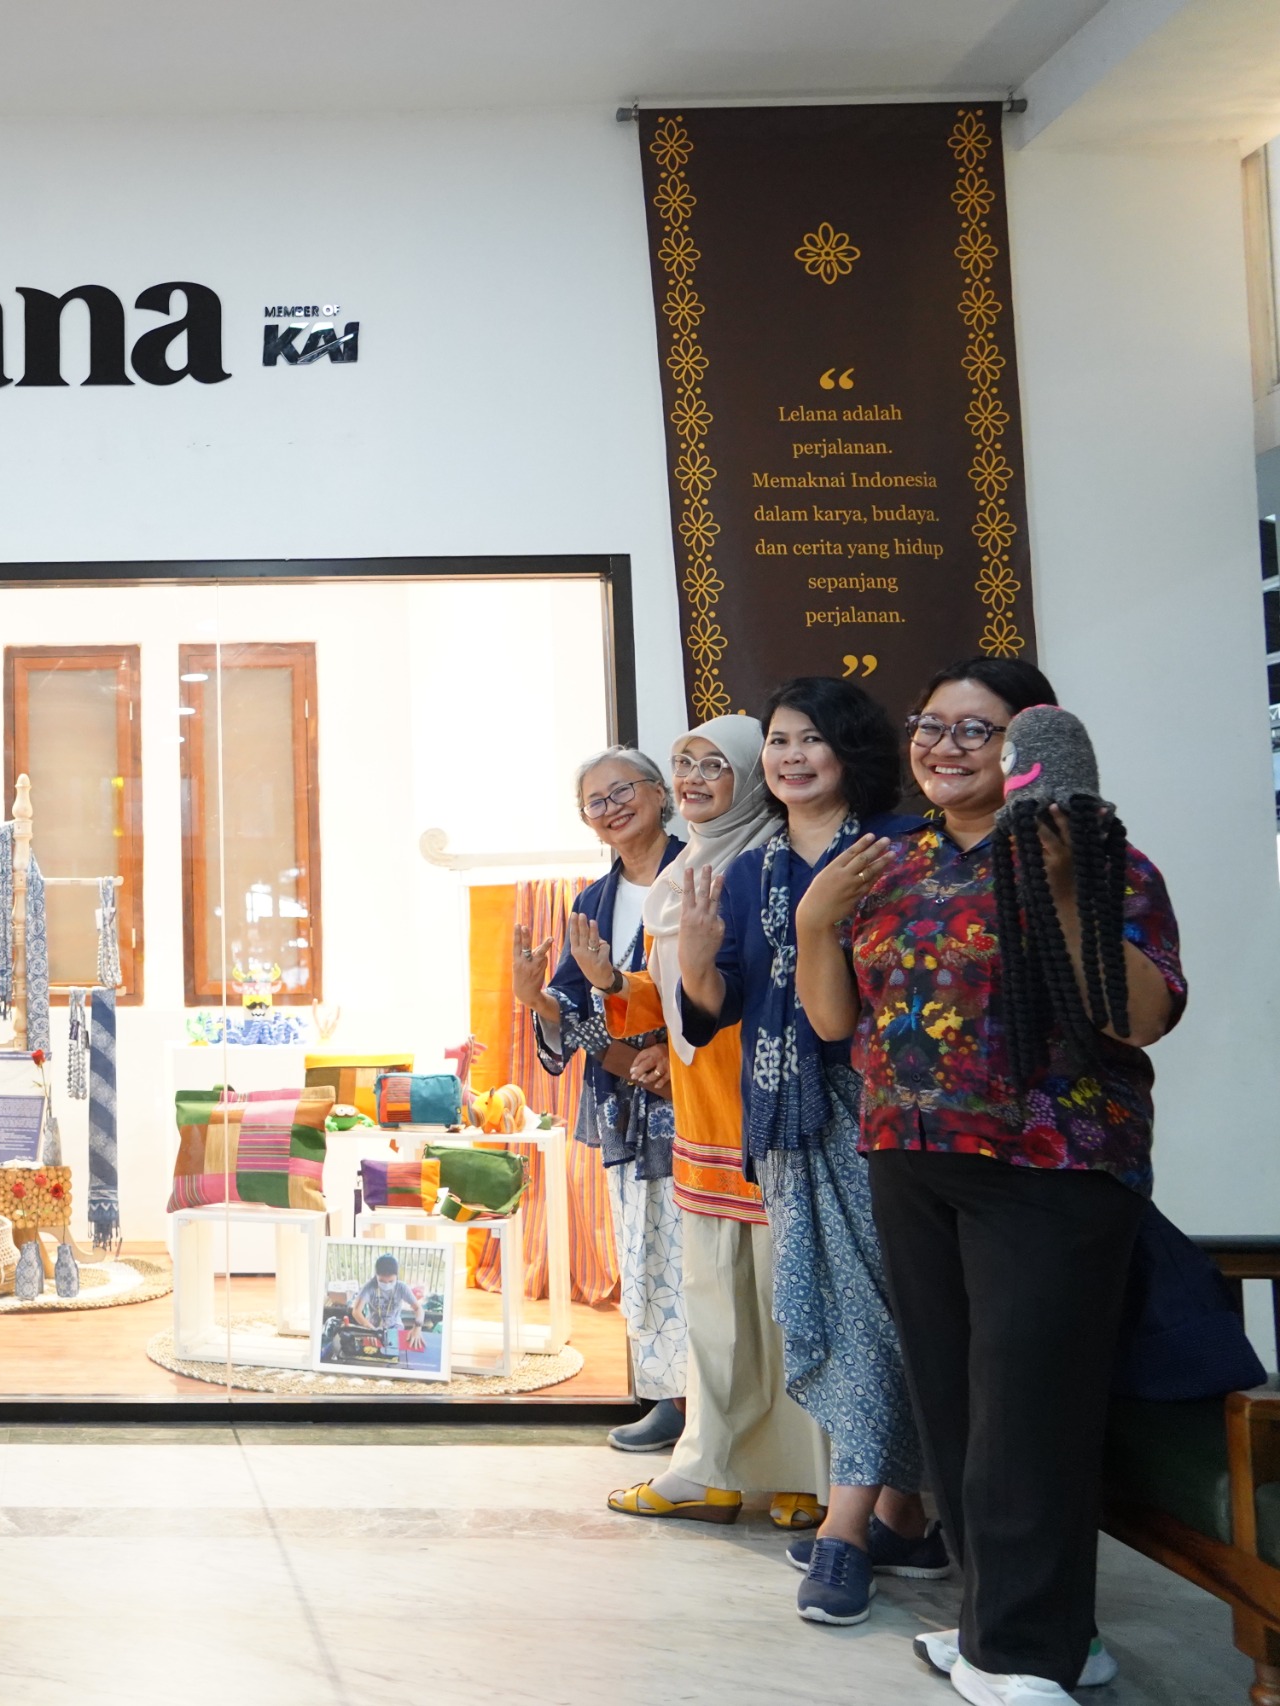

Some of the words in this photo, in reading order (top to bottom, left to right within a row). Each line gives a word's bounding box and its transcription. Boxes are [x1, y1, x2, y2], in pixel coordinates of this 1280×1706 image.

[264, 305, 320, 318] MEMBER
[322, 304, 341, 317] OF
[262, 321, 360, 366] KAI
[778, 404, 839, 422] Lelana
[842, 403, 903, 422] adalah
[791, 437, 893, 459] perjalanan.
[751, 471, 846, 489] Memaknai
[851, 470, 937, 489] Indonesia
[753, 504, 809, 522] dalam
[812, 504, 868, 526] karya,
[754, 538, 789, 556] dan
[792, 538, 844, 556] cerita
[846, 543, 890, 560] yang
[893, 538, 944, 560] hidup
[807, 572, 899, 594] sepanjang
[804, 605, 906, 628] perjalanan.
